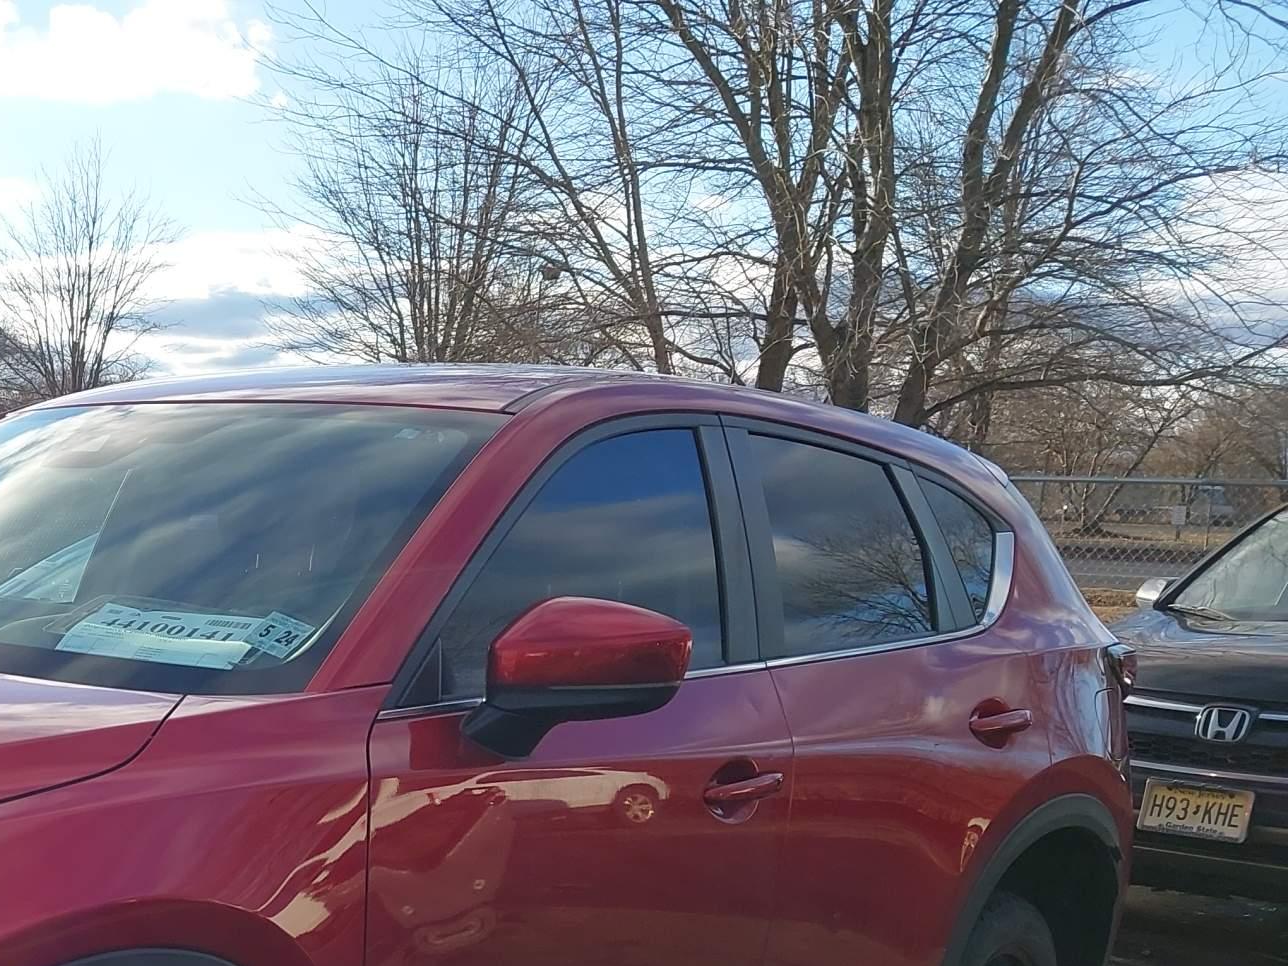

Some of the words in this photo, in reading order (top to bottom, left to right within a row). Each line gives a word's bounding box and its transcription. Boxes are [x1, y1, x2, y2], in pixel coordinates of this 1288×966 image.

[100, 618, 234, 641] 44100141
[259, 623, 278, 638] 5
[273, 630, 300, 647] 24
[1149, 794, 1190, 821] H93
[1201, 801, 1244, 828] KHE
[1165, 821, 1194, 832] Garden
[1196, 825, 1218, 835] State
